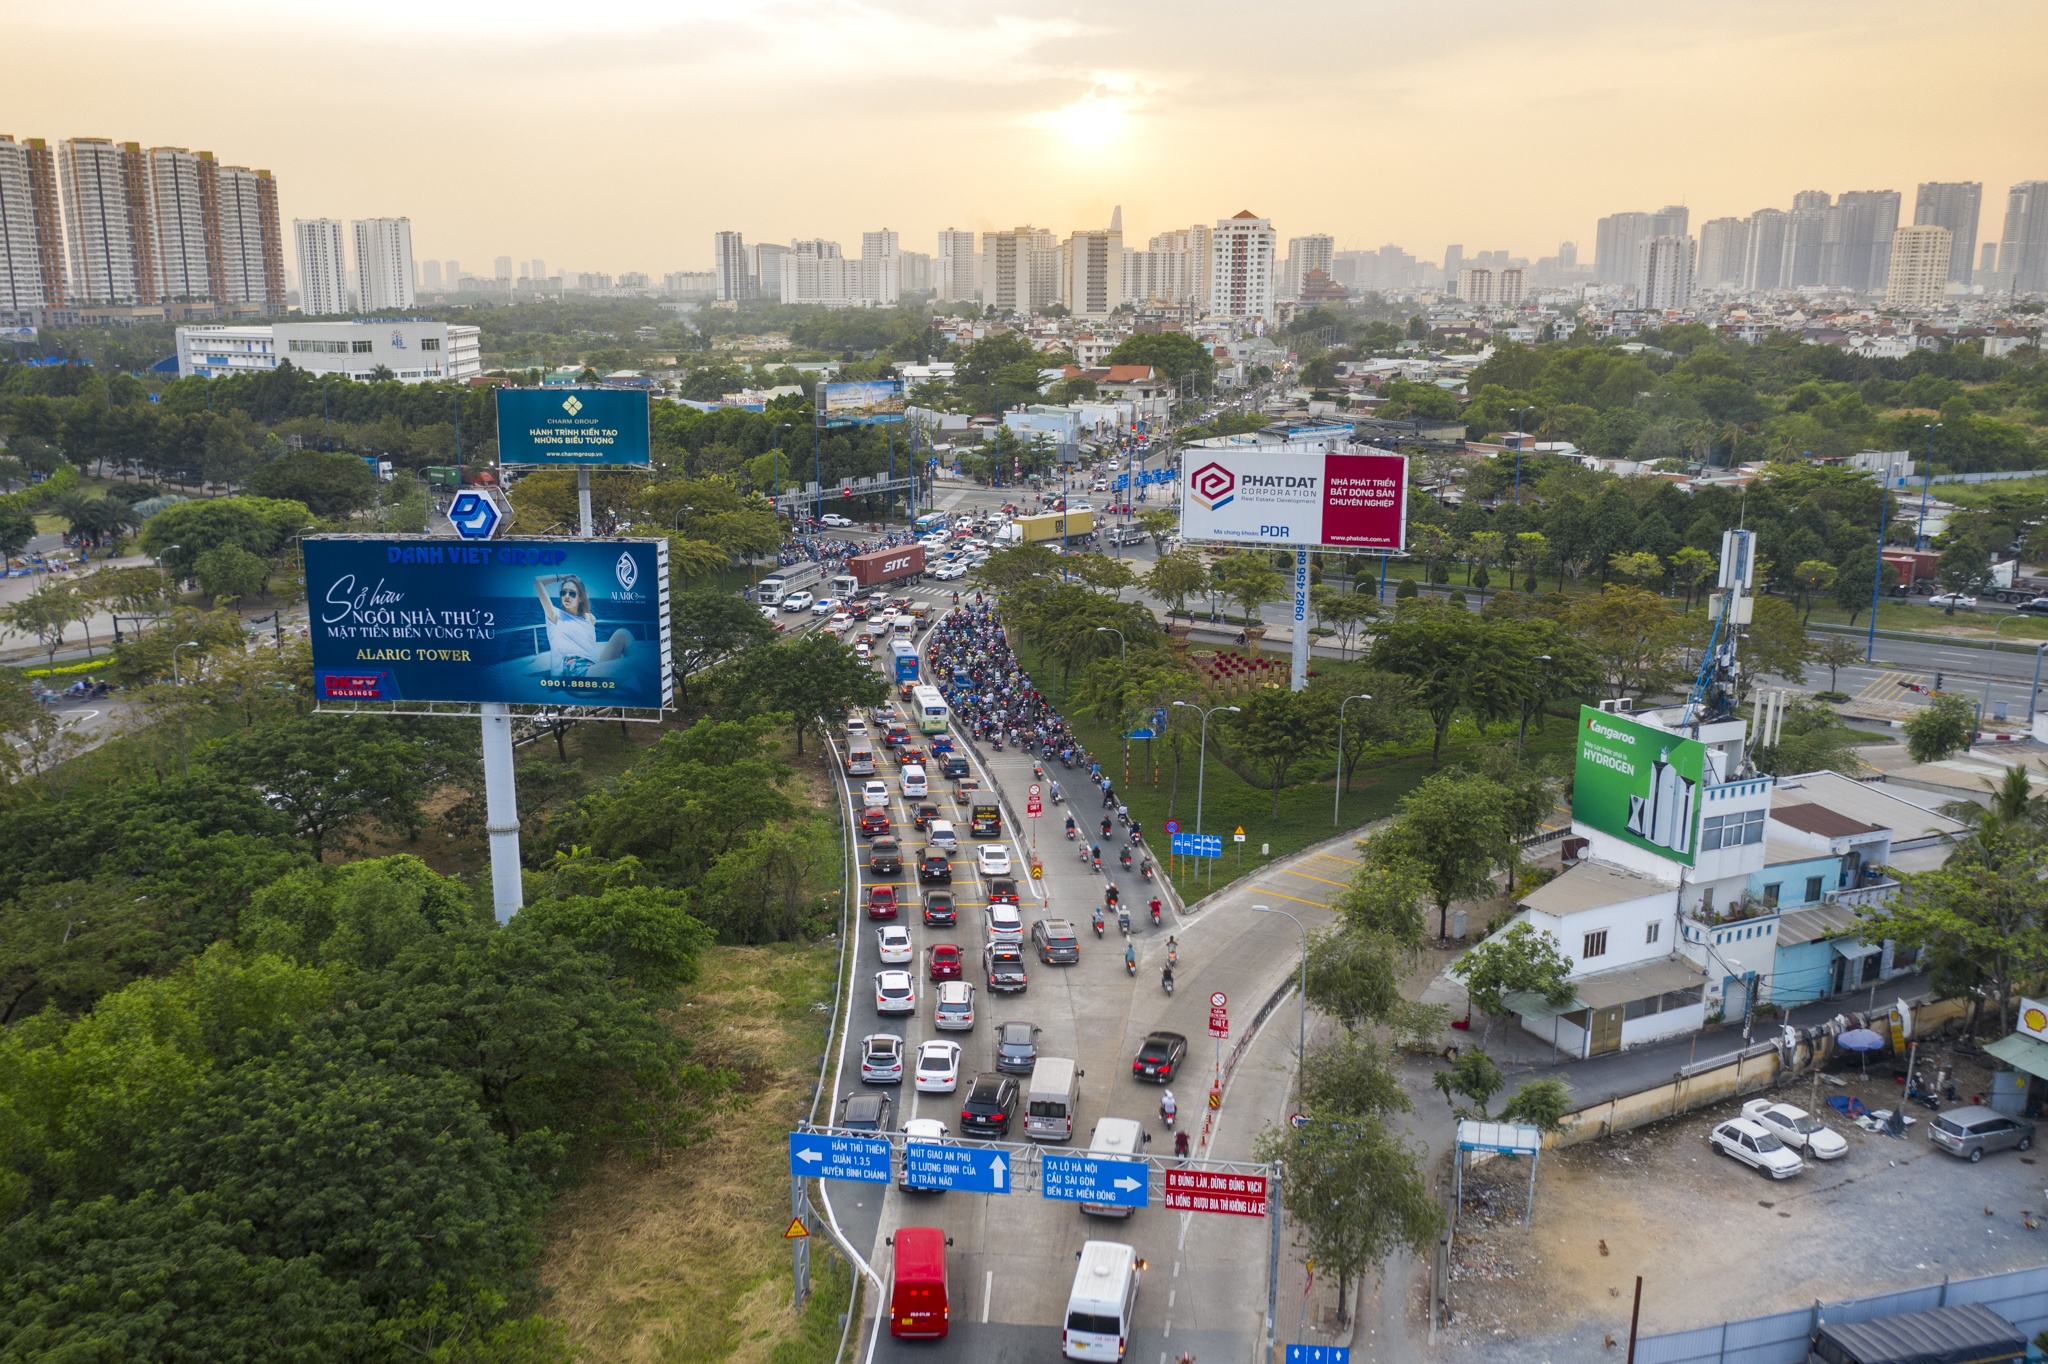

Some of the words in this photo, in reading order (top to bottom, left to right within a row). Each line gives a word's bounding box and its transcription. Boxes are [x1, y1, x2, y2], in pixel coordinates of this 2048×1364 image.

[529, 428, 553, 436] HÀNH
[555, 428, 579, 436] TRÌNH
[602, 429, 618, 437] TẠO
[1242, 475, 1317, 488] PHATDAT
[1331, 478, 1348, 486] NHÀ
[1350, 478, 1371, 487] PHÁT
[1242, 488, 1317, 497] CORPORATION
[1349, 488, 1374, 498] ĐỘNG
[1376, 489, 1395, 498] SẢN
[1330, 498, 1362, 507] CHUYÊN
[1364, 499, 1394, 508] NGHIỆP
[1261, 526, 1290, 537] PDR
[388, 547, 443, 565] DANH
[448, 547, 492, 565] VIET
[498, 548, 567, 566] GROUP
[883, 557, 911, 573] SITC
[1296, 568, 1306, 590] 456
[322, 574, 369, 623] Sở
[1295, 592, 1306, 622] 0982
[352, 608, 396, 625] NGÔI
[400, 608, 436, 625] NHÀ
[441, 609, 480, 626] THỨ
[484, 612, 495, 626] 2
[328, 625, 356, 639] MẶT
[424, 626, 463, 639] VŨNG
[466, 628, 495, 640] TÀU
[356, 649, 411, 661] ALARIC
[416, 650, 471, 662] TOWER
[540, 680, 615, 689] 0901.8888.02
[1586, 718, 1636, 745] Kangaroo
[1584, 748, 1635, 776] HYDROGEN
[850, 1141, 863, 1153] THỦ
[866, 1144, 886, 1155] THIÊM
[911, 1146, 925, 1158] NÚT
[927, 1150, 943, 1160] GIAO
[945, 1152, 955, 1161] AN
[957, 1151, 971, 1163] PHÚ
[833, 1154, 852, 1166] QUẬN
[1047, 1161, 1058, 1171] XA
[1060, 1160, 1070, 1173] LỘ
[1072, 1161, 1082, 1173] HÀ
[1085, 1163, 1098, 1175] NỘI
[822, 1166, 844, 1178] HUYỆN
[846, 1166, 862, 1178] BÌNH
[864, 1169, 887, 1181] CHÁNH
[919, 1162, 942, 1173] LƯƠNG
[943, 1164, 960, 1176] ĐỊNH
[963, 1164, 977, 1176] CỦA
[939, 1175, 953, 1187] NÃO
[1065, 1173, 1078, 1185] SÀI
[1080, 1175, 1096, 1187] GÒN
[1170, 1174, 1177, 1186] ĐI
[1178, 1173, 1195, 1188] ĐÚNG
[1229, 1177, 1245, 1192] ĐÚNG
[1247, 1181, 1263, 1194] VẠCH
[1047, 1184, 1062, 1197] BẾN
[1064, 1188, 1074, 1198] XE
[1097, 1190, 1116, 1202] ĐÔNG
[1166, 1193, 1174, 1206] ĐÃ
[1210, 1198, 1219, 1210] BIA
[1220, 1197, 1229, 1211] THÌ
[1229, 1199, 1246, 1213] KHÔNG
[1248, 1200, 1257, 1214] LÁI
[1258, 1203, 1265, 1214] XE
